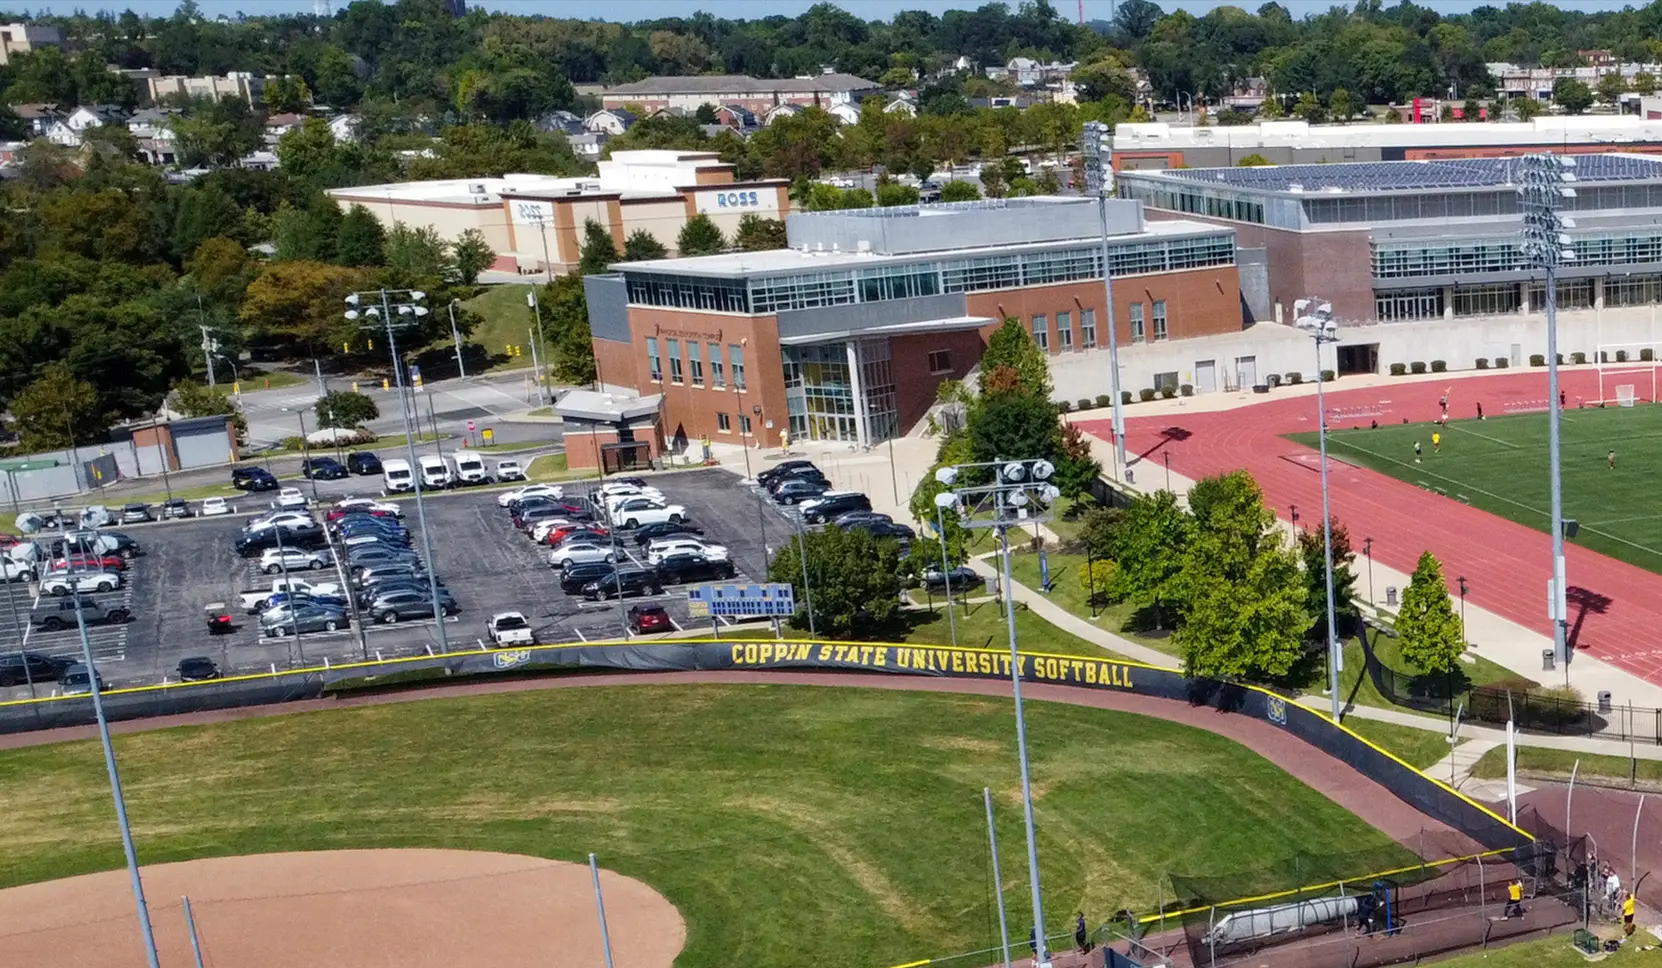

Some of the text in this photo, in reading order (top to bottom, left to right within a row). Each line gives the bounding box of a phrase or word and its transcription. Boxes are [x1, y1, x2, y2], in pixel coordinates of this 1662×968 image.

[717, 191, 759, 208] ROSS
[731, 643, 1133, 688] COPPIN STATE UNIVERSITY SOFTBALL
